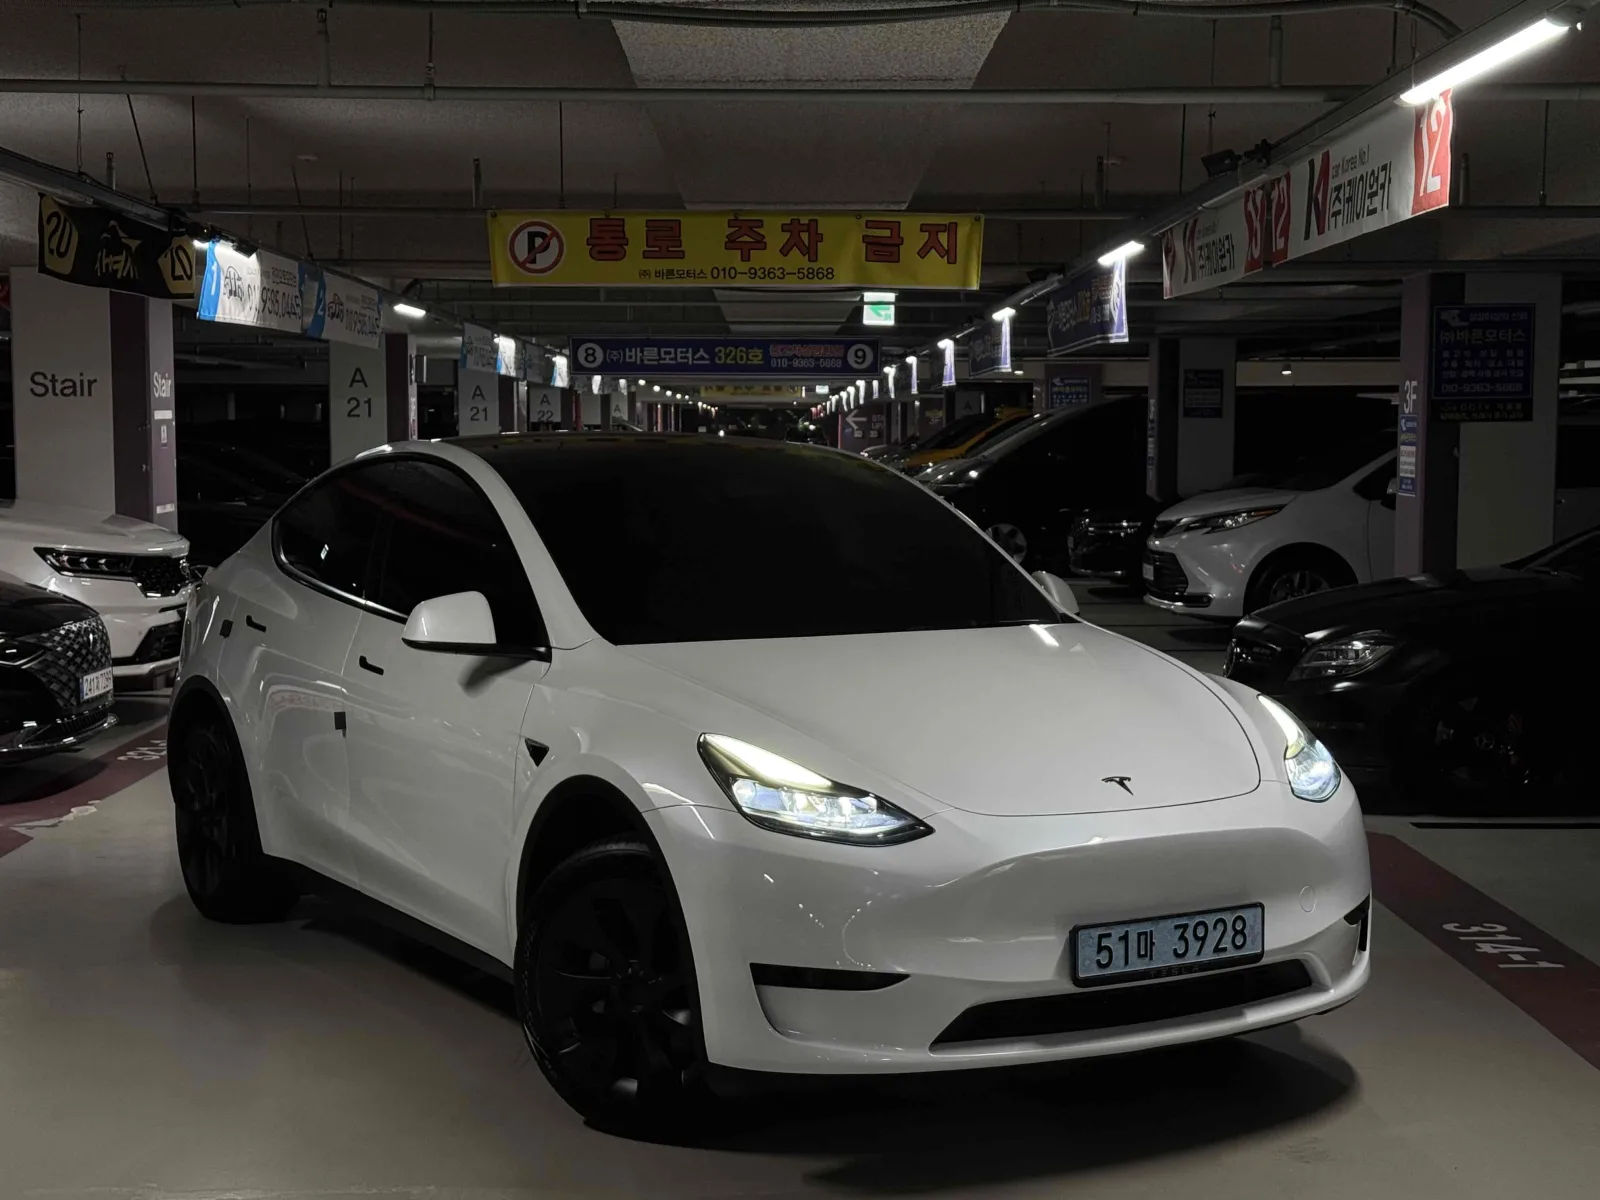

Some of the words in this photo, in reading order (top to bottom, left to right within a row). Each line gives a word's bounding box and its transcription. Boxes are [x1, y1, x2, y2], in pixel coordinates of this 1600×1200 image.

[1420, 96, 1446, 197] 12
[1328, 161, 1391, 231] (주)케이원카
[587, 218, 686, 261] 통로
[725, 218, 823, 262] 주차
[863, 219, 958, 264] 금지
[655, 268, 707, 281] 바른모터스
[711, 267, 835, 280] 010-9363-5868
[584, 347, 597, 364] 8
[715, 346, 765, 366] 326호
[854, 348, 866, 365] 9
[30, 371, 98, 398] Stair
[153, 371, 172, 398] Stair
[349, 367, 368, 388] A
[472, 385, 486, 401] A
[540, 394, 551, 406] A
[1403, 380, 1418, 414] 3F
[347, 397, 372, 418] 21
[470, 406, 488, 422] 21
[1096, 929, 1156, 969] 51마
[1173, 914, 1247, 959] 3928
[1441, 922, 1565, 969] 314-1
